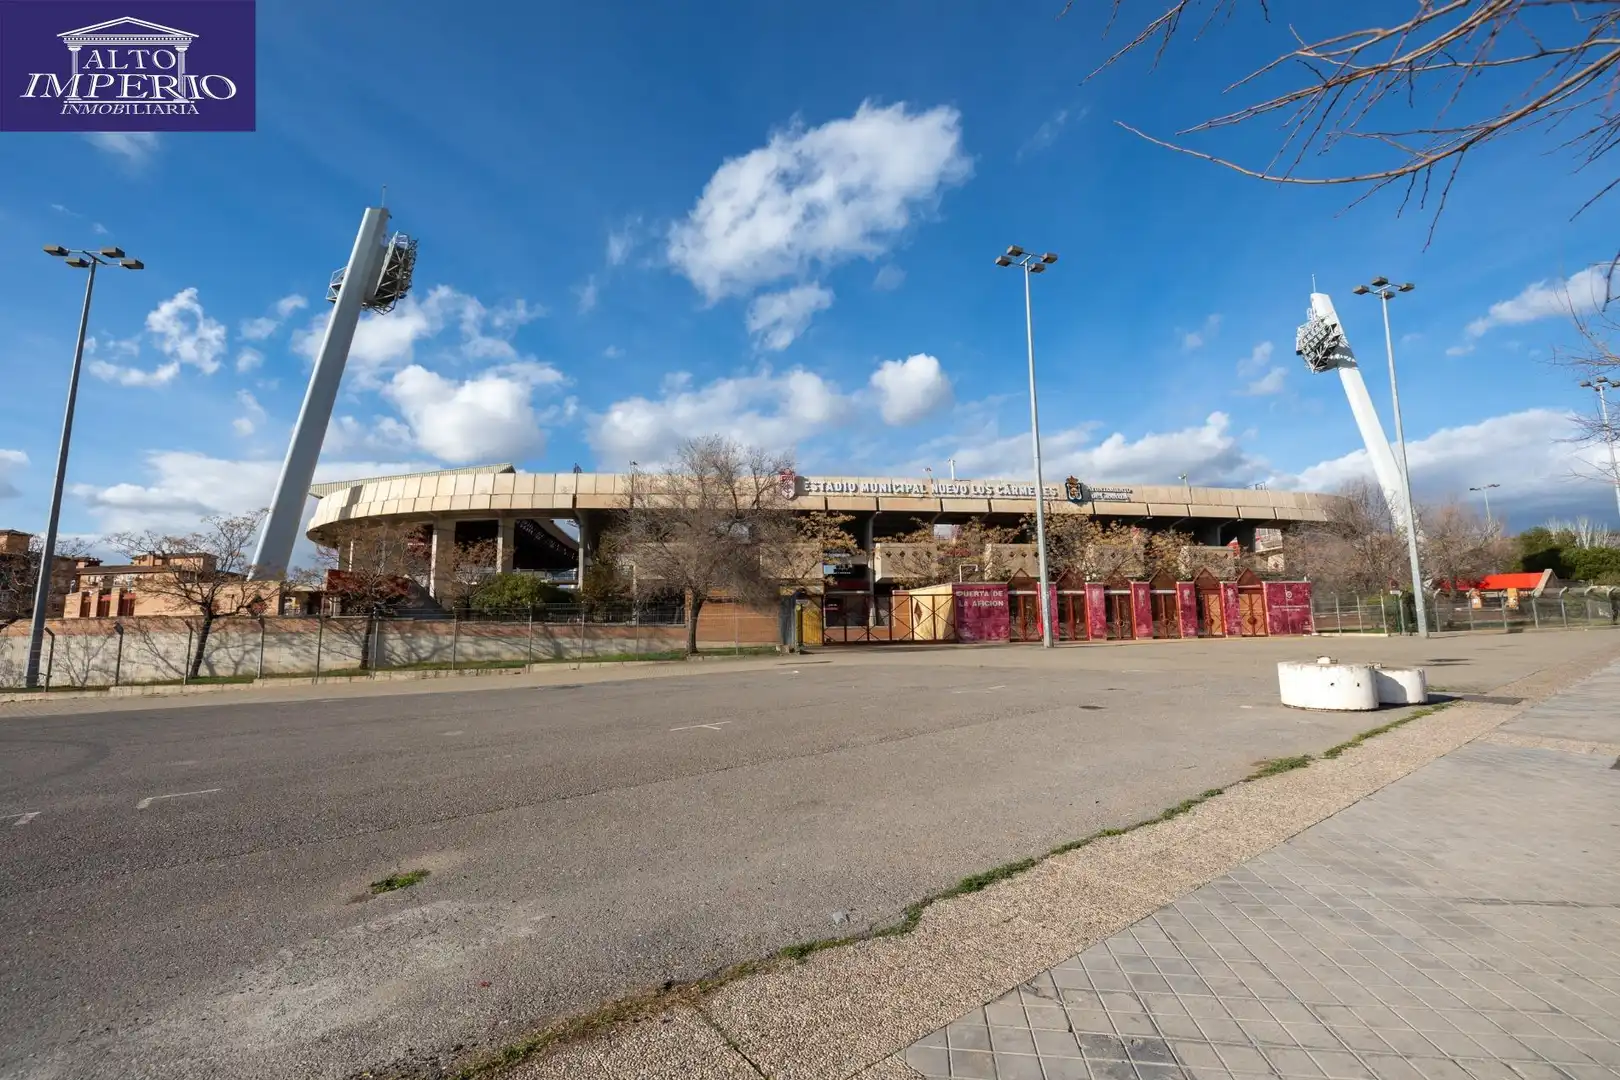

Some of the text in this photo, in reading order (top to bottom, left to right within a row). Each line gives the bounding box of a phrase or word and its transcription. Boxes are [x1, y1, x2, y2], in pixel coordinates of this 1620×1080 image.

[804, 481, 858, 493] ESTADIO
[861, 482, 929, 495] MUNICIPAL
[932, 484, 969, 495] NUEVO
[972, 485, 994, 495] LOS
